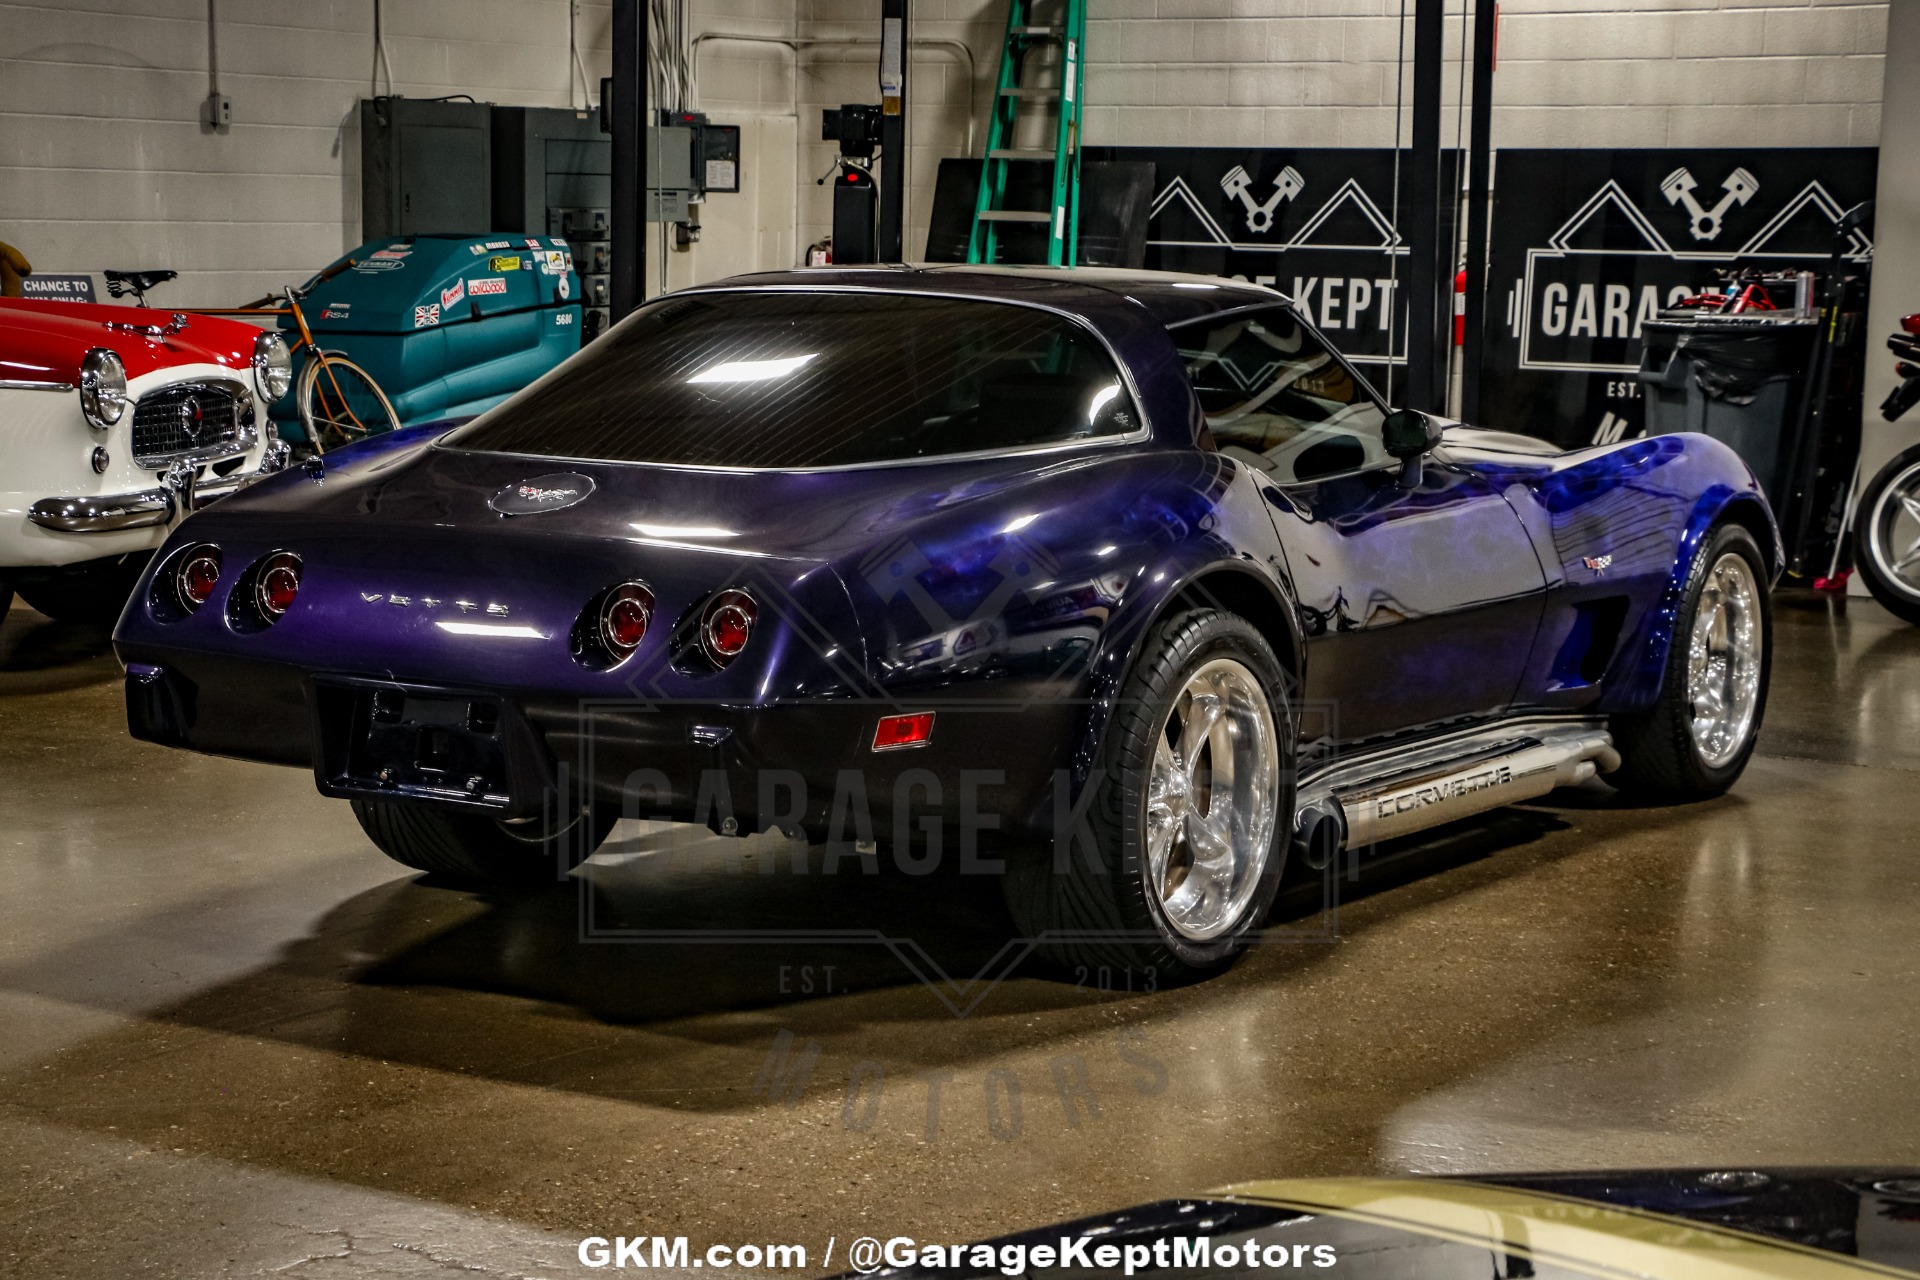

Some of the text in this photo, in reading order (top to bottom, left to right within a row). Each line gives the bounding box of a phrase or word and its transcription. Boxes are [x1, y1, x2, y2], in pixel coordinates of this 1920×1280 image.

[23, 280, 89, 292] CHANCE TO
[1292, 276, 1398, 330] KEPT
[1607, 381, 1642, 399] EST.
[360, 592, 509, 618] VETTE
[1377, 765, 1513, 819] CORVETTE
